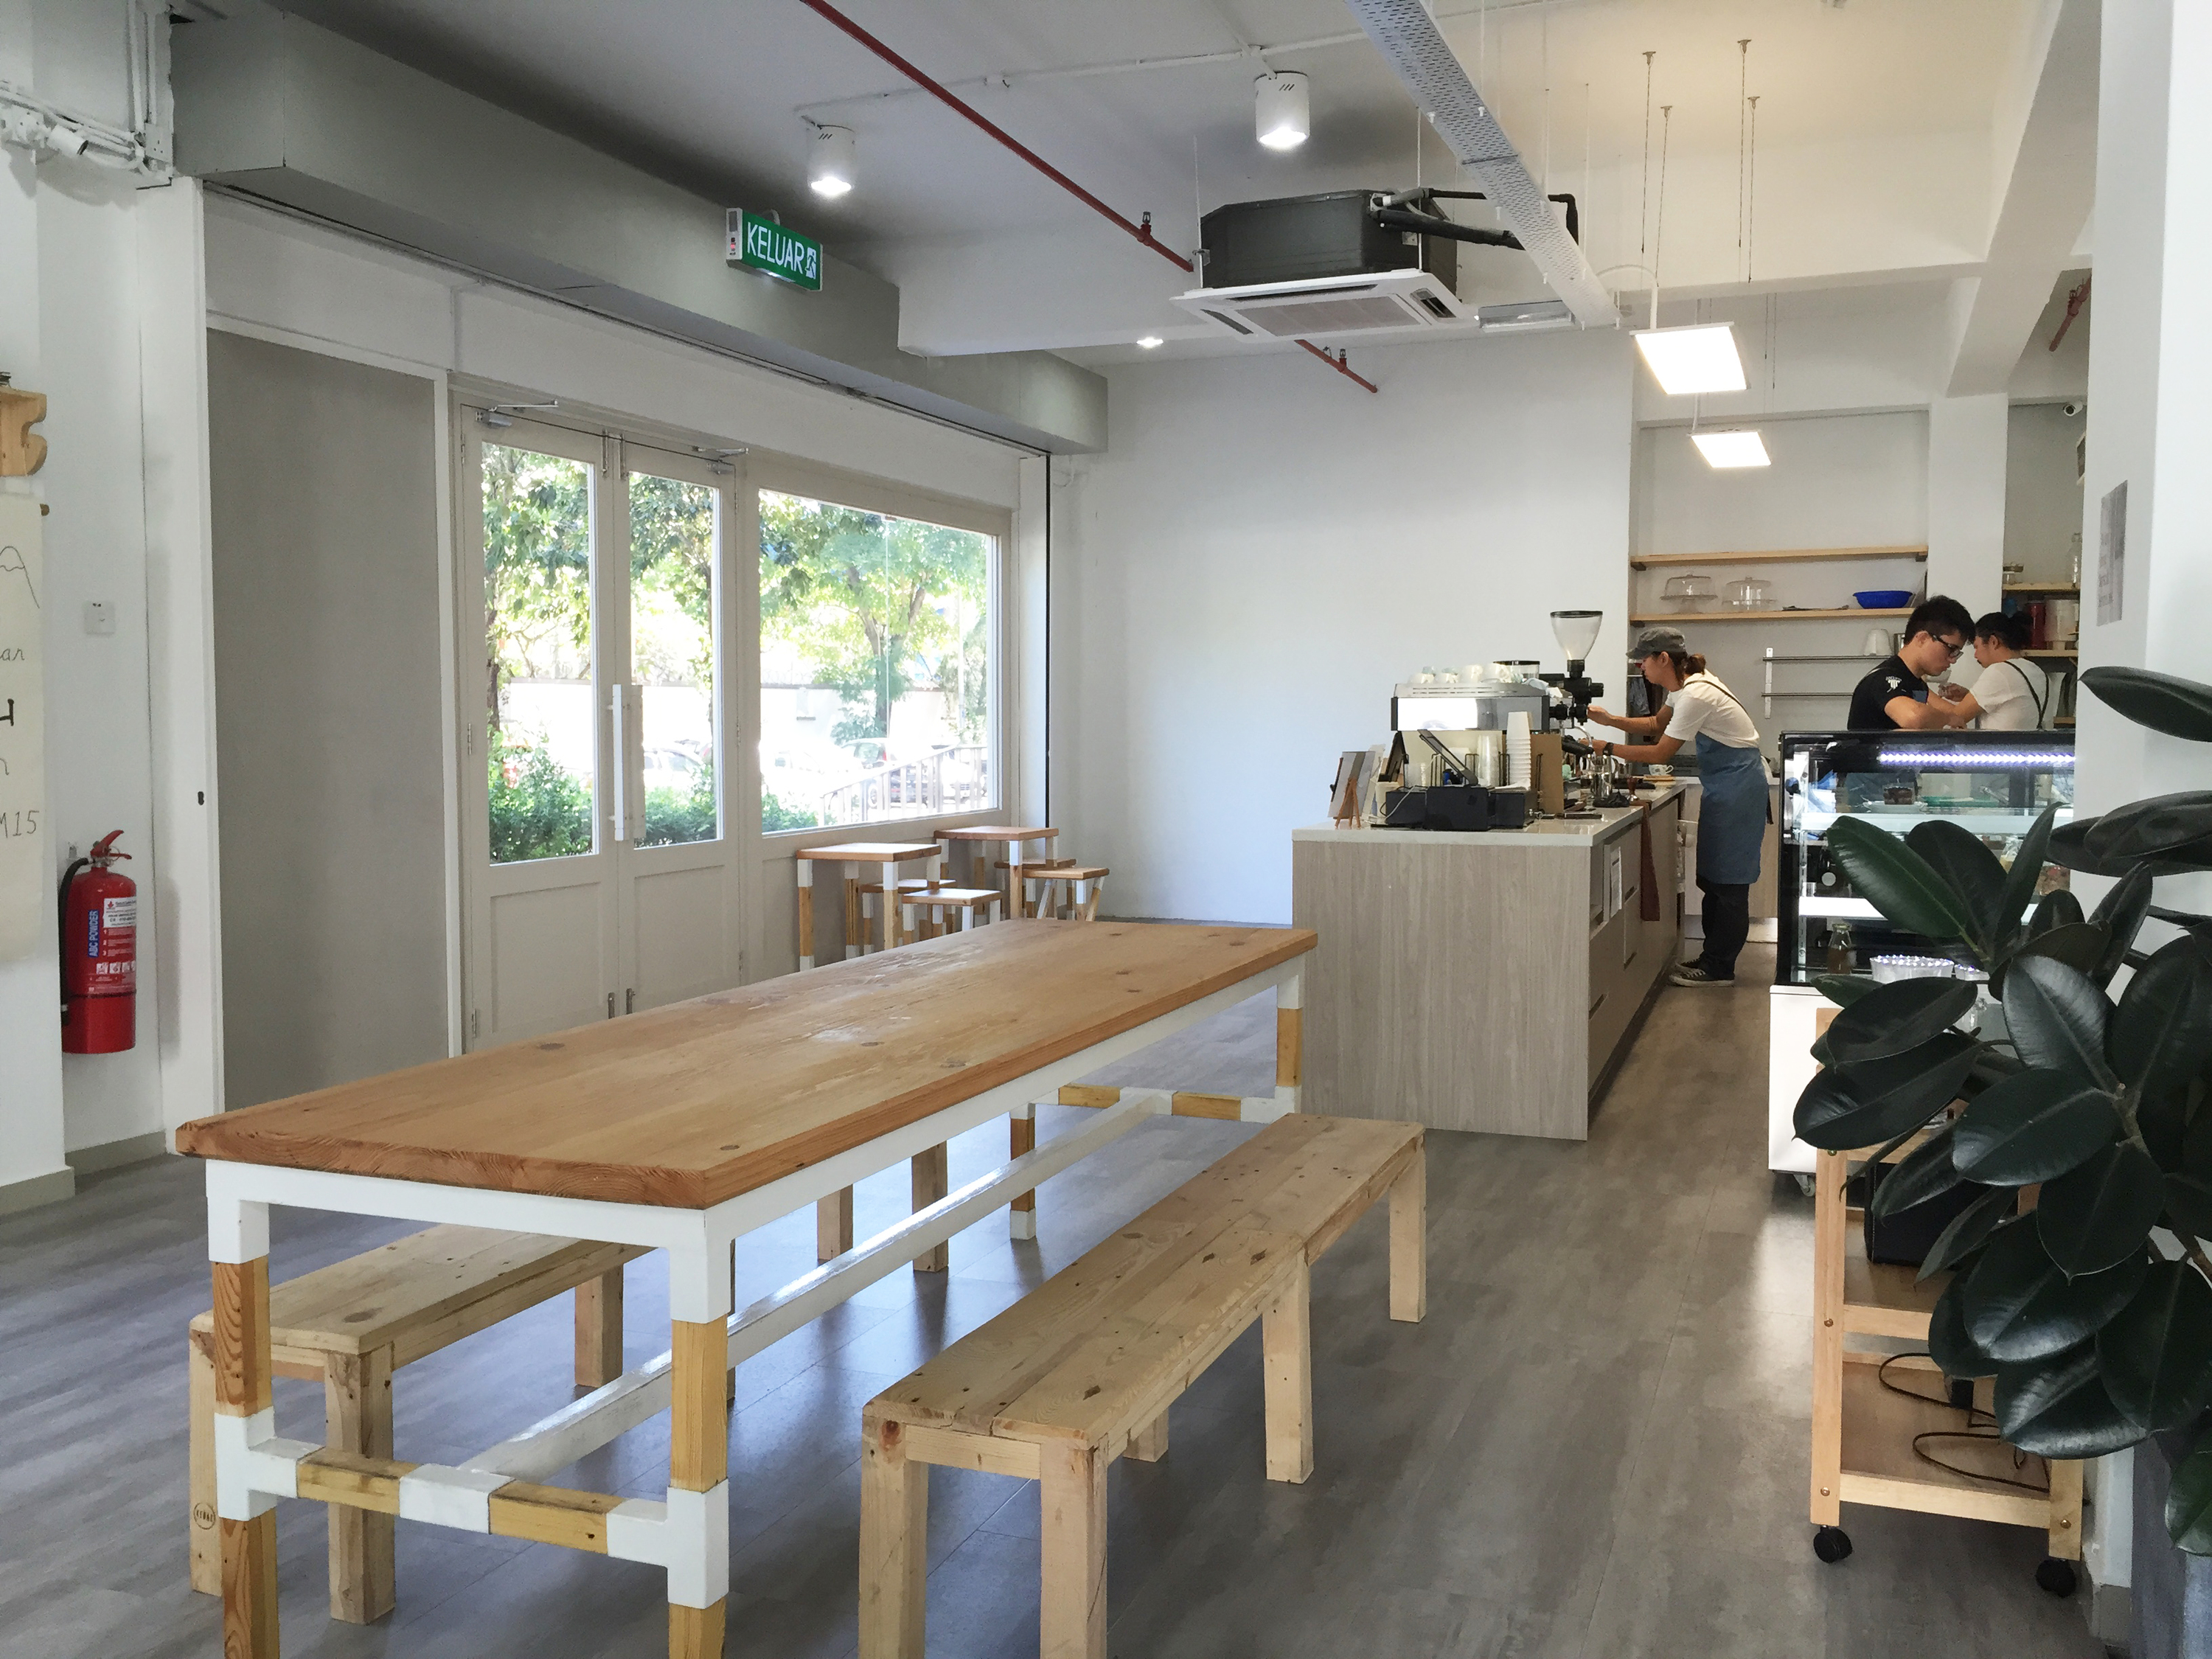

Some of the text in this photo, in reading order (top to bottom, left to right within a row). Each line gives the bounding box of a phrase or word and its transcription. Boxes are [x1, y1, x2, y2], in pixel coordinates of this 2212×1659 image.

[747, 222, 804, 274] KELUAR
[88, 911, 98, 956] ABC POWDER
